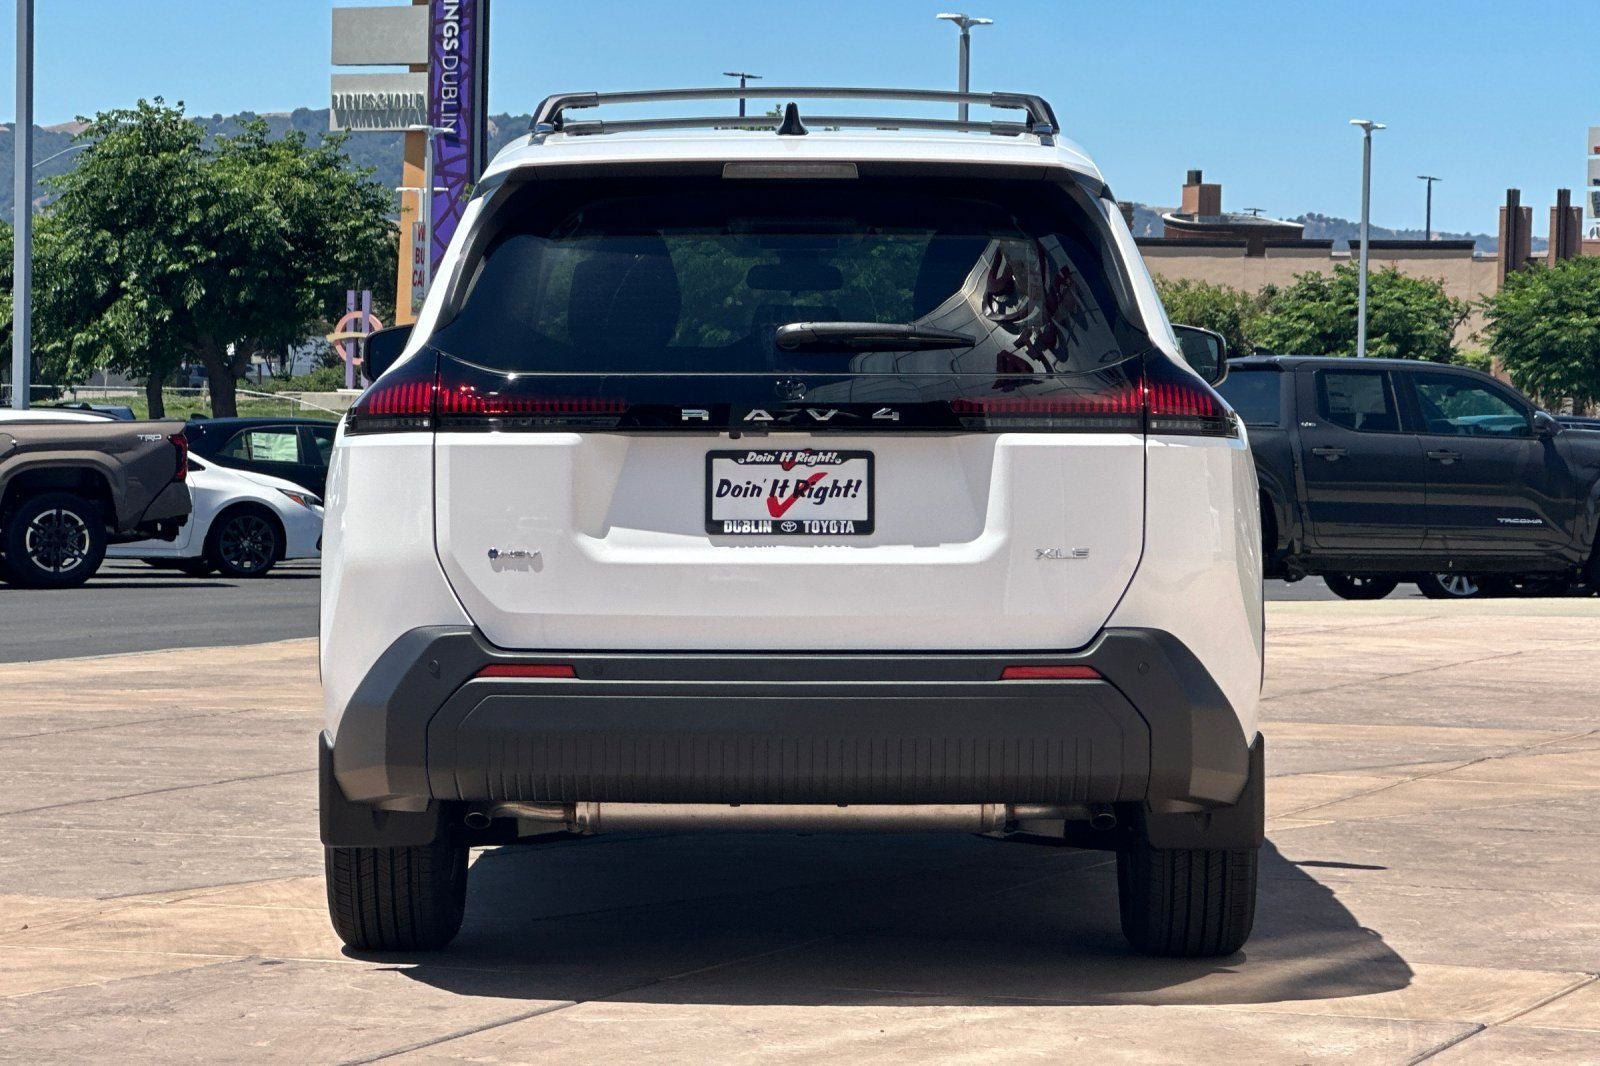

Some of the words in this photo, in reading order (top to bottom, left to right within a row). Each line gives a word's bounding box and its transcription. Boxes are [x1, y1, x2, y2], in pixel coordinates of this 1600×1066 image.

[443, 0, 459, 50] INGS
[441, 55, 459, 134] DUBLIN
[681, 407, 900, 421] RAV4
[136, 433, 162, 442] TRD
[746, 451, 778, 463] Doin'
[780, 451, 793, 463] It
[795, 451, 837, 466] Right!
[715, 478, 767, 498] Doin'
[769, 478, 790, 498] It
[793, 478, 863, 506] Right!
[723, 520, 772, 534] DUBLIN
[803, 520, 855, 534] TOYOTA
[1035, 548, 1090, 560] XLE
